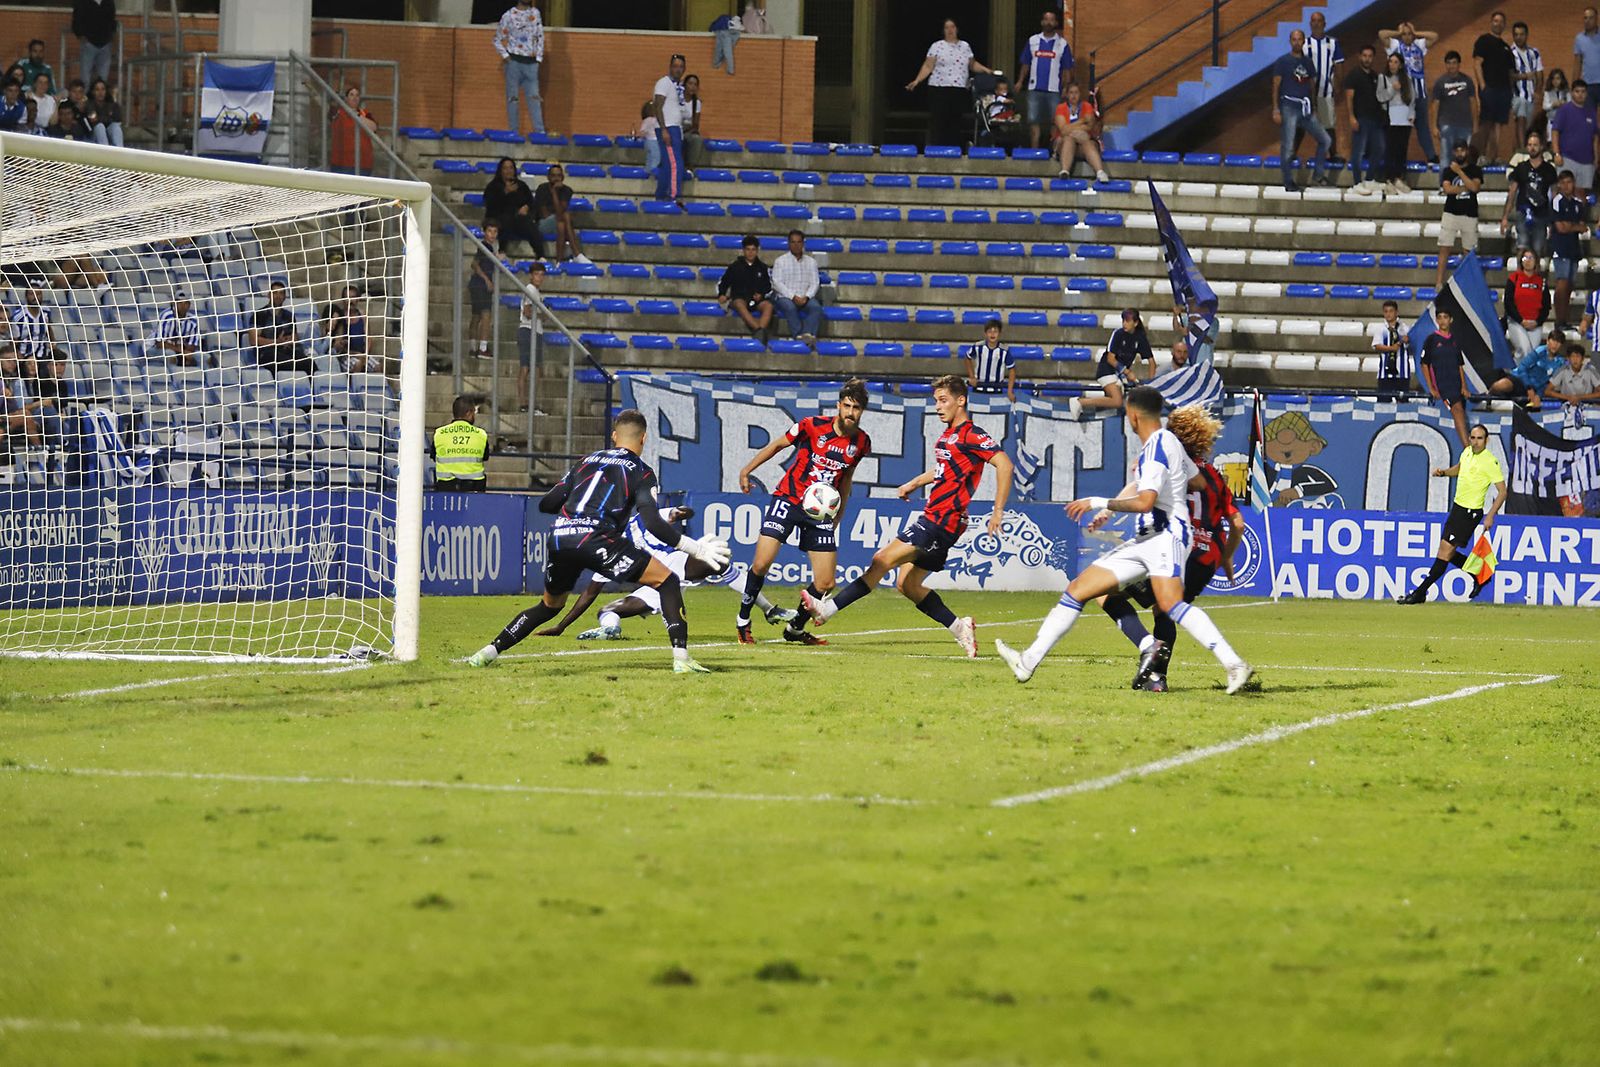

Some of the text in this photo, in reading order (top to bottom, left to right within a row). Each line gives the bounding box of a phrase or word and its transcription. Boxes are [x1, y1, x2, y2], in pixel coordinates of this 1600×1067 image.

[452, 436, 471, 445] 827
[576, 470, 604, 512] 1
[771, 499, 790, 519] 15
[26, 505, 79, 546] ESPAÑA
[174, 500, 303, 560] CAJA RURAL
[365, 501, 500, 593] Crcampo
[210, 562, 267, 591] DEL SUR
